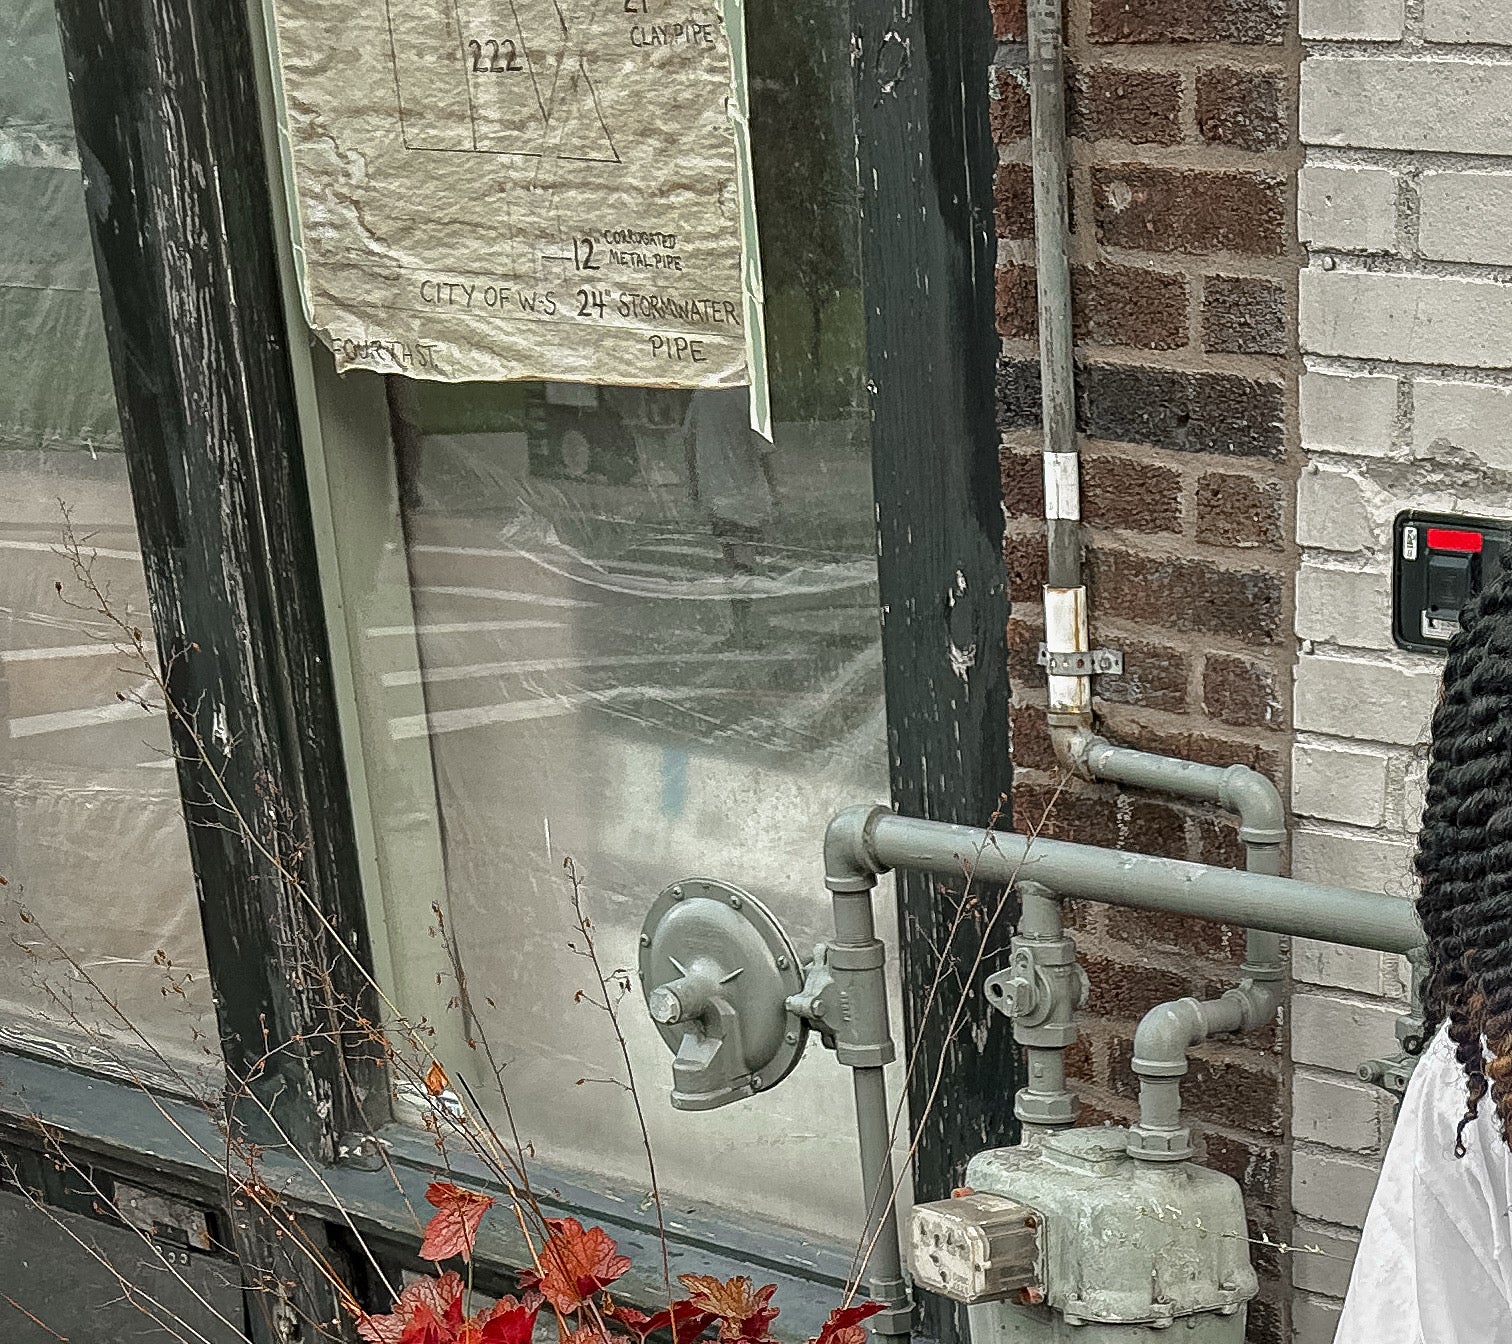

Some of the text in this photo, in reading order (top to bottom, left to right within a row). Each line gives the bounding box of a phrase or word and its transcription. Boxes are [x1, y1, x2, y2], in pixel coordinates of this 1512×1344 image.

[629, 22, 714, 48] CLAY PIPE
[468, 38, 523, 73] 222
[609, 249, 683, 272] METAL PIPE
[419, 279, 476, 308] CITY
[483, 286, 511, 309] OF
[616, 291, 741, 326] STORMWATER
[648, 334, 708, 363] PIPE
